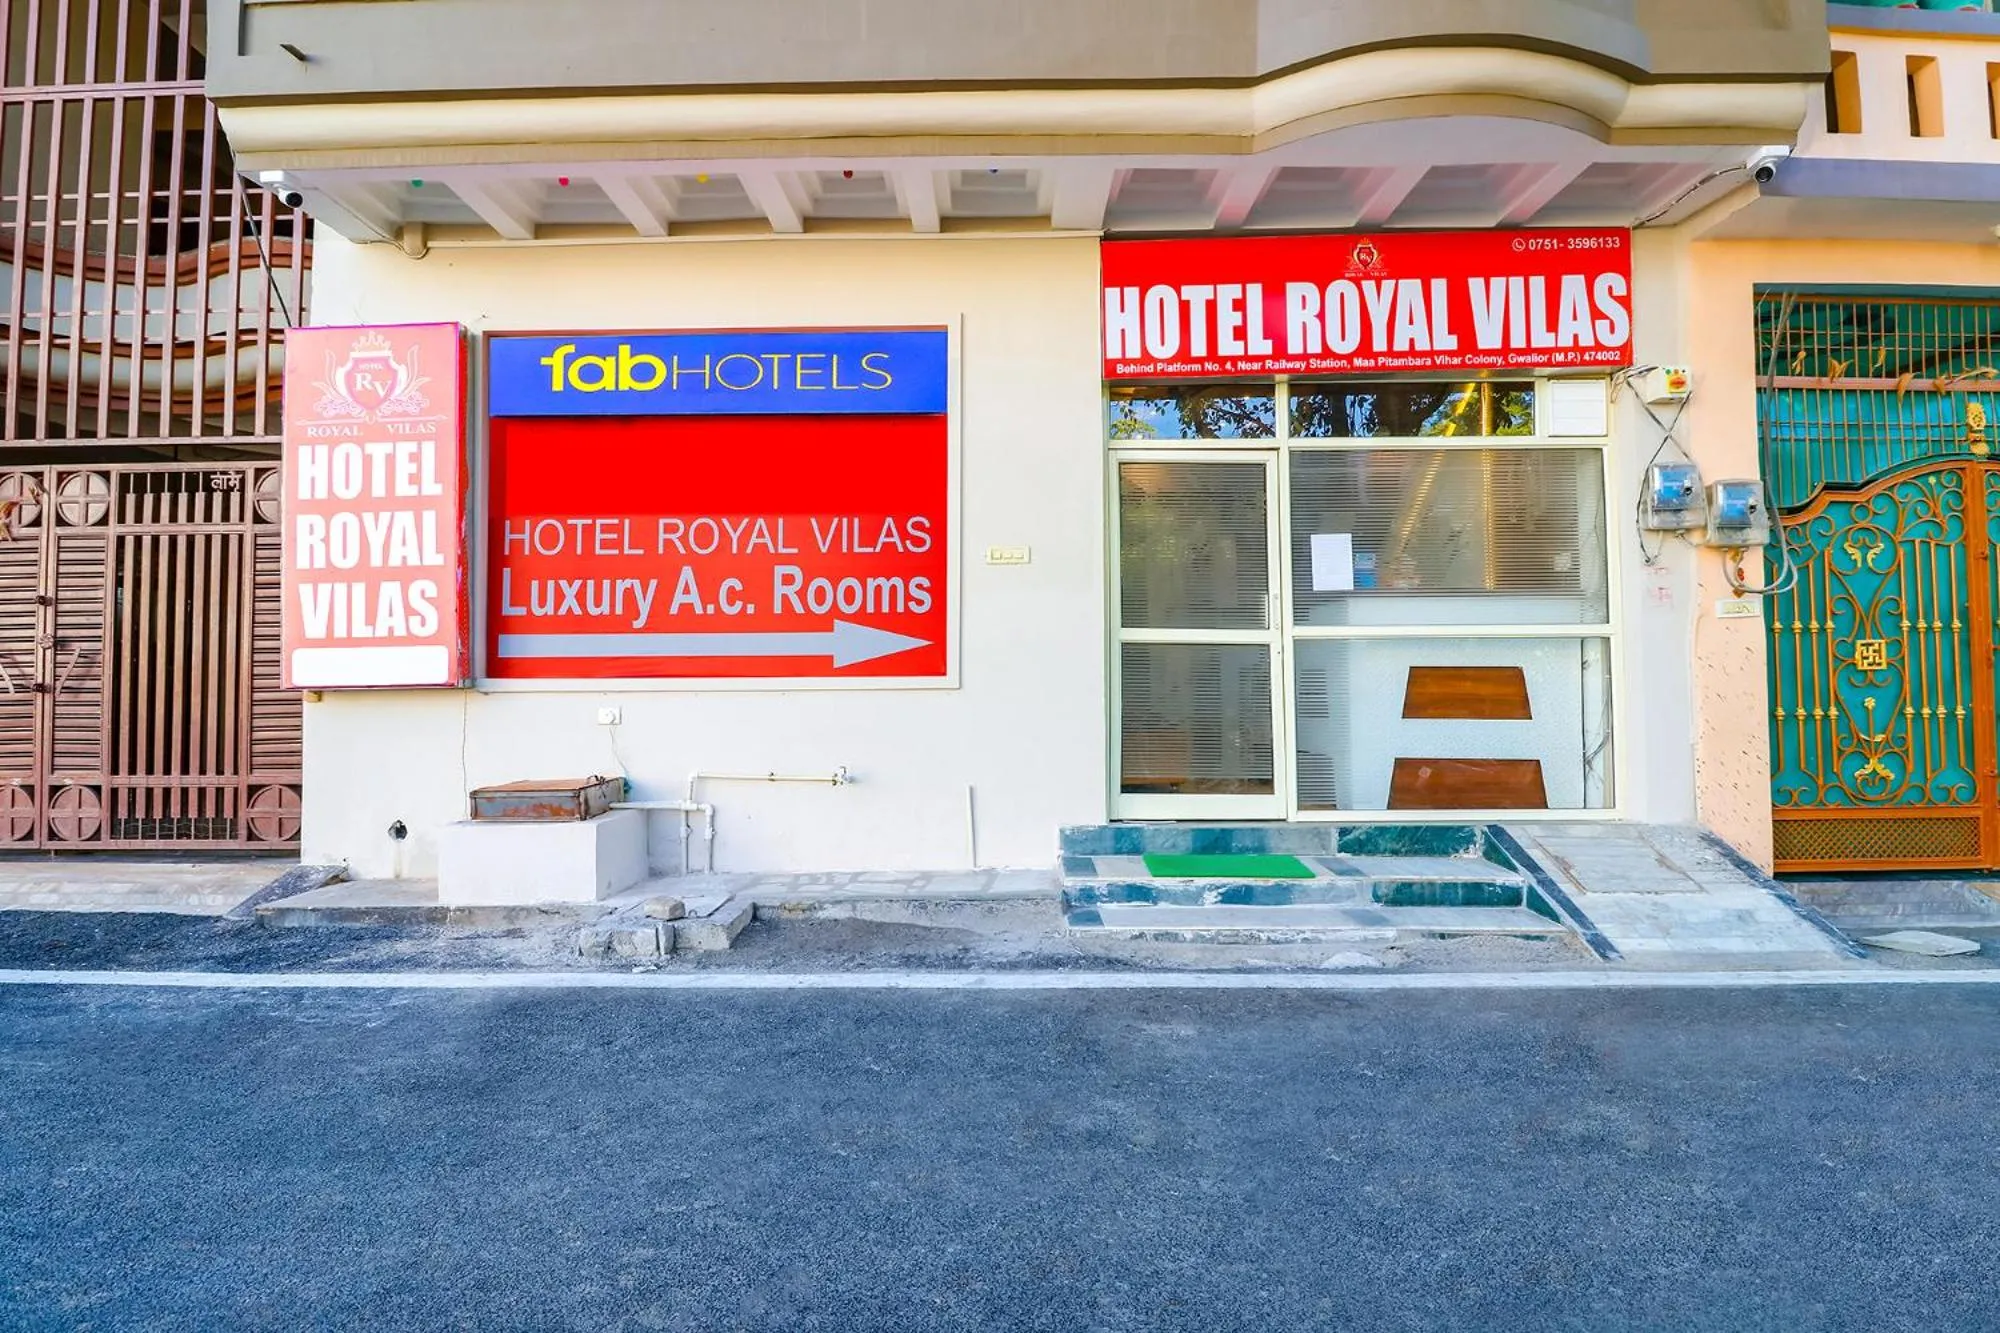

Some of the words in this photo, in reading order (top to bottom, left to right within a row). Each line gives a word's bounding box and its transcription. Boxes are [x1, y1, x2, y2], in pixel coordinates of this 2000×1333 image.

[1528, 237, 1564, 251] 0751-
[1568, 236, 1621, 251] 3596133
[1104, 283, 1272, 359] HOTEL
[1287, 279, 1457, 355] ROYAL
[1467, 272, 1630, 350] VILAS
[1116, 363, 1154, 374] Behind
[1157, 362, 1201, 373] Platform
[1204, 361, 1222, 372] No.
[1225, 361, 1235, 372] 4,
[1237, 361, 1261, 371] Near
[1265, 359, 1306, 373] Railway
[1309, 358, 1350, 370] Station,
[1353, 358, 1375, 367] Maa
[1378, 356, 1431, 367] Pitambara
[1434, 354, 1462, 365] Vihar
[1465, 354, 1505, 367] Colony,
[1508, 353, 1549, 364] Gwalior
[1551, 352, 1581, 364] (M.P.)
[1583, 351, 1621, 362] 474002
[306, 427, 363, 438] ROYAL
[386, 423, 437, 434] VILAS
[298, 440, 443, 500] HOTEL
[296, 510, 444, 569] ROYAL
[505, 519, 644, 556] HOTEL
[658, 518, 798, 554] ROYAL
[810, 516, 932, 554] VILAS
[298, 579, 438, 639] VILAS
[502, 567, 658, 629] Luxury
[669, 565, 755, 615] A.c.
[773, 564, 932, 614] Rooms
